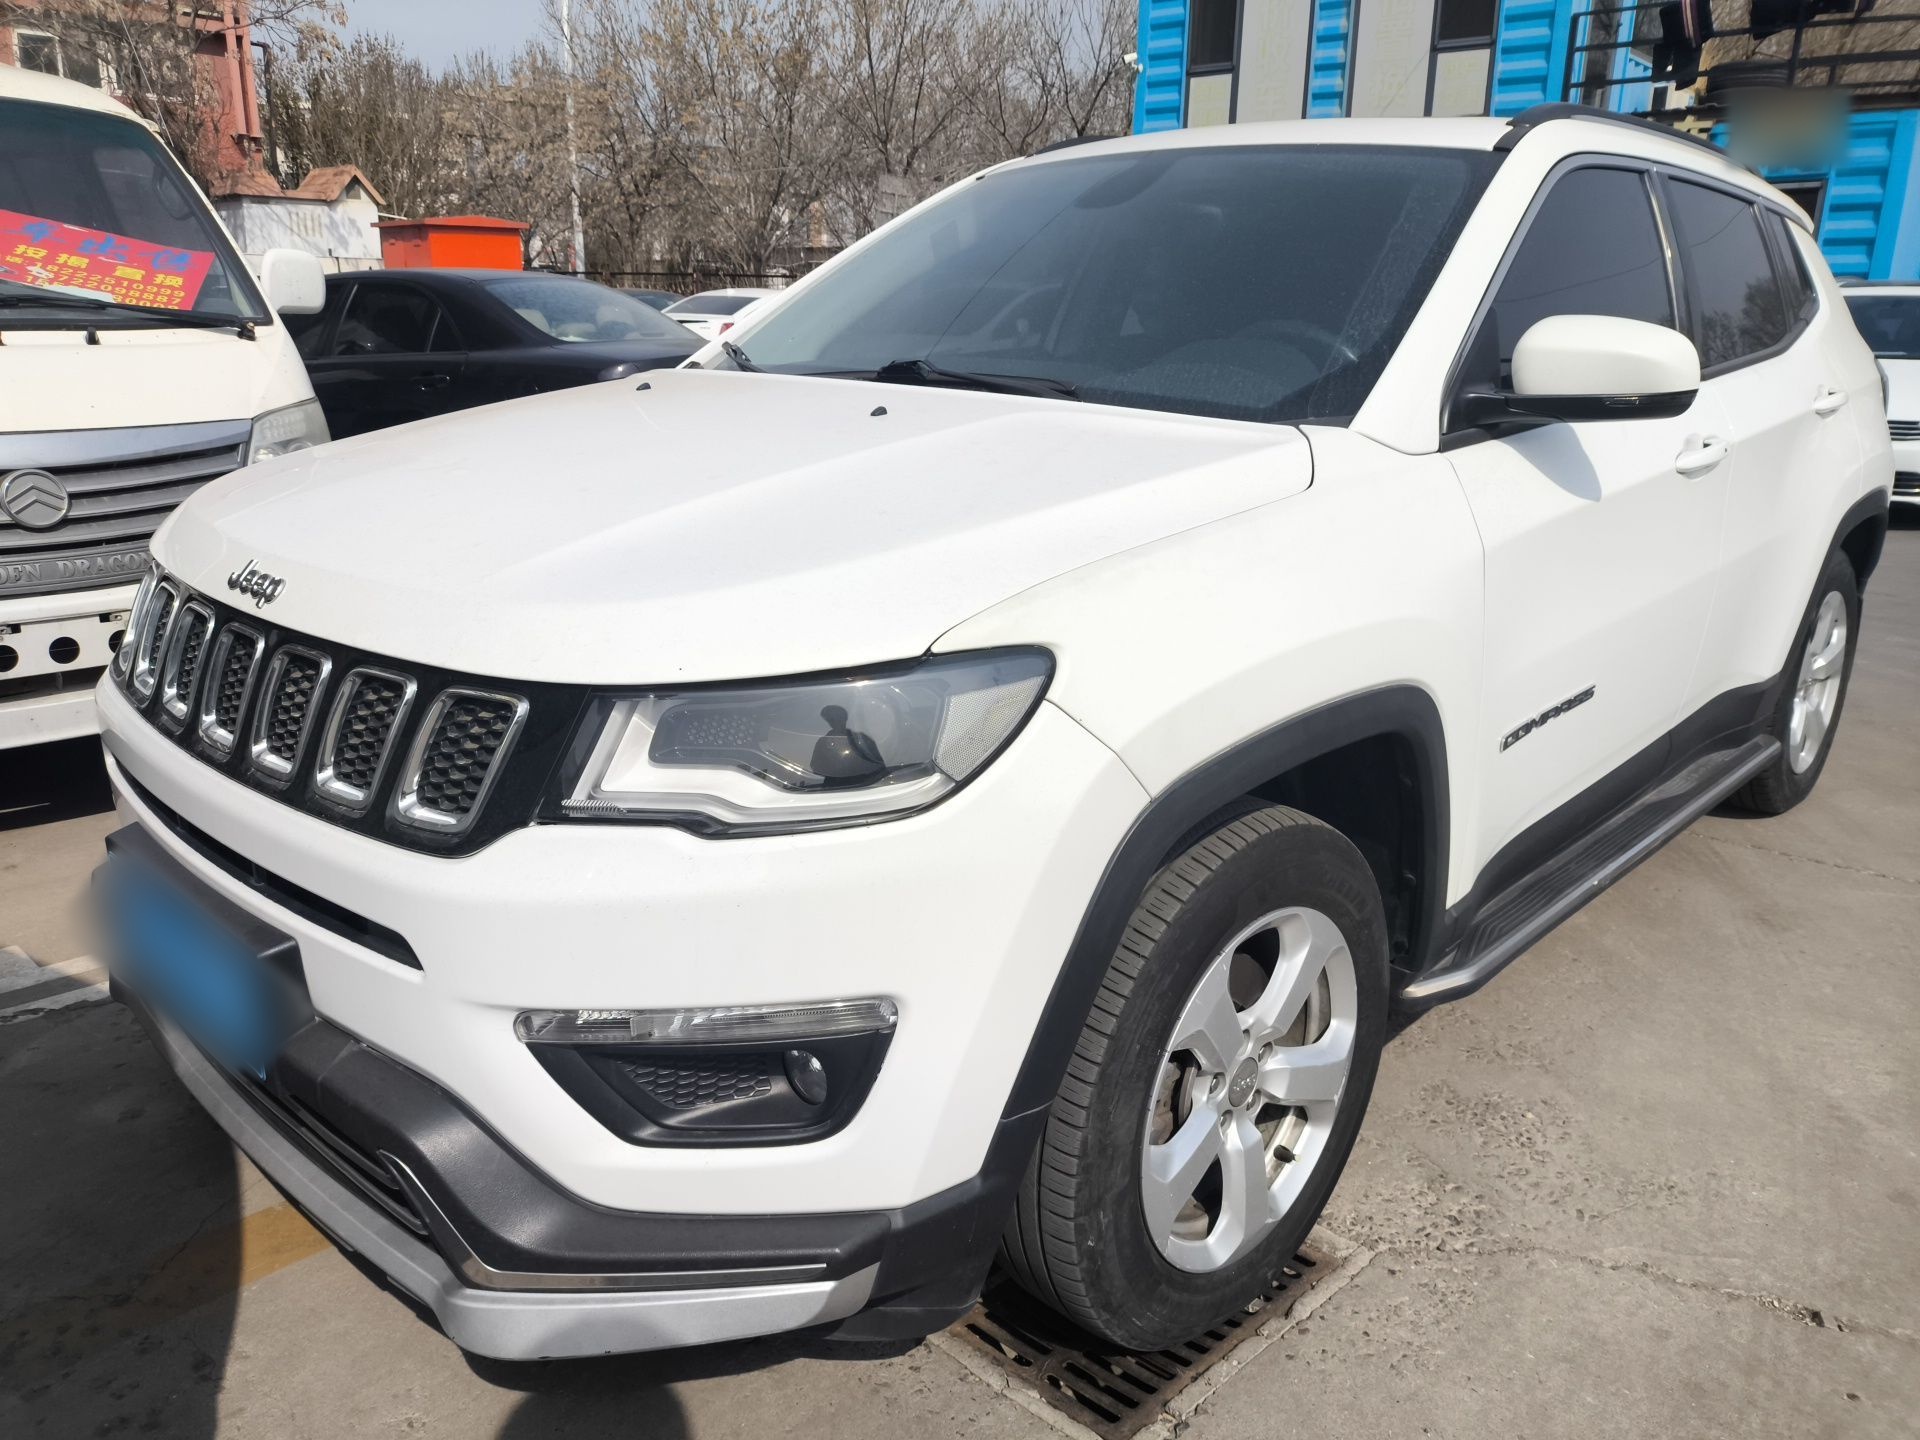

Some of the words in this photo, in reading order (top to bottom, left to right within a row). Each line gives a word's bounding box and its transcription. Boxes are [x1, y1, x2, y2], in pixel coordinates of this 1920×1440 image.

[13, 245, 89, 269] 按揭
[56, 551, 154, 578] DRAGON
[228, 559, 287, 610] Jeep
[1500, 684, 1596, 752] COMPASS
